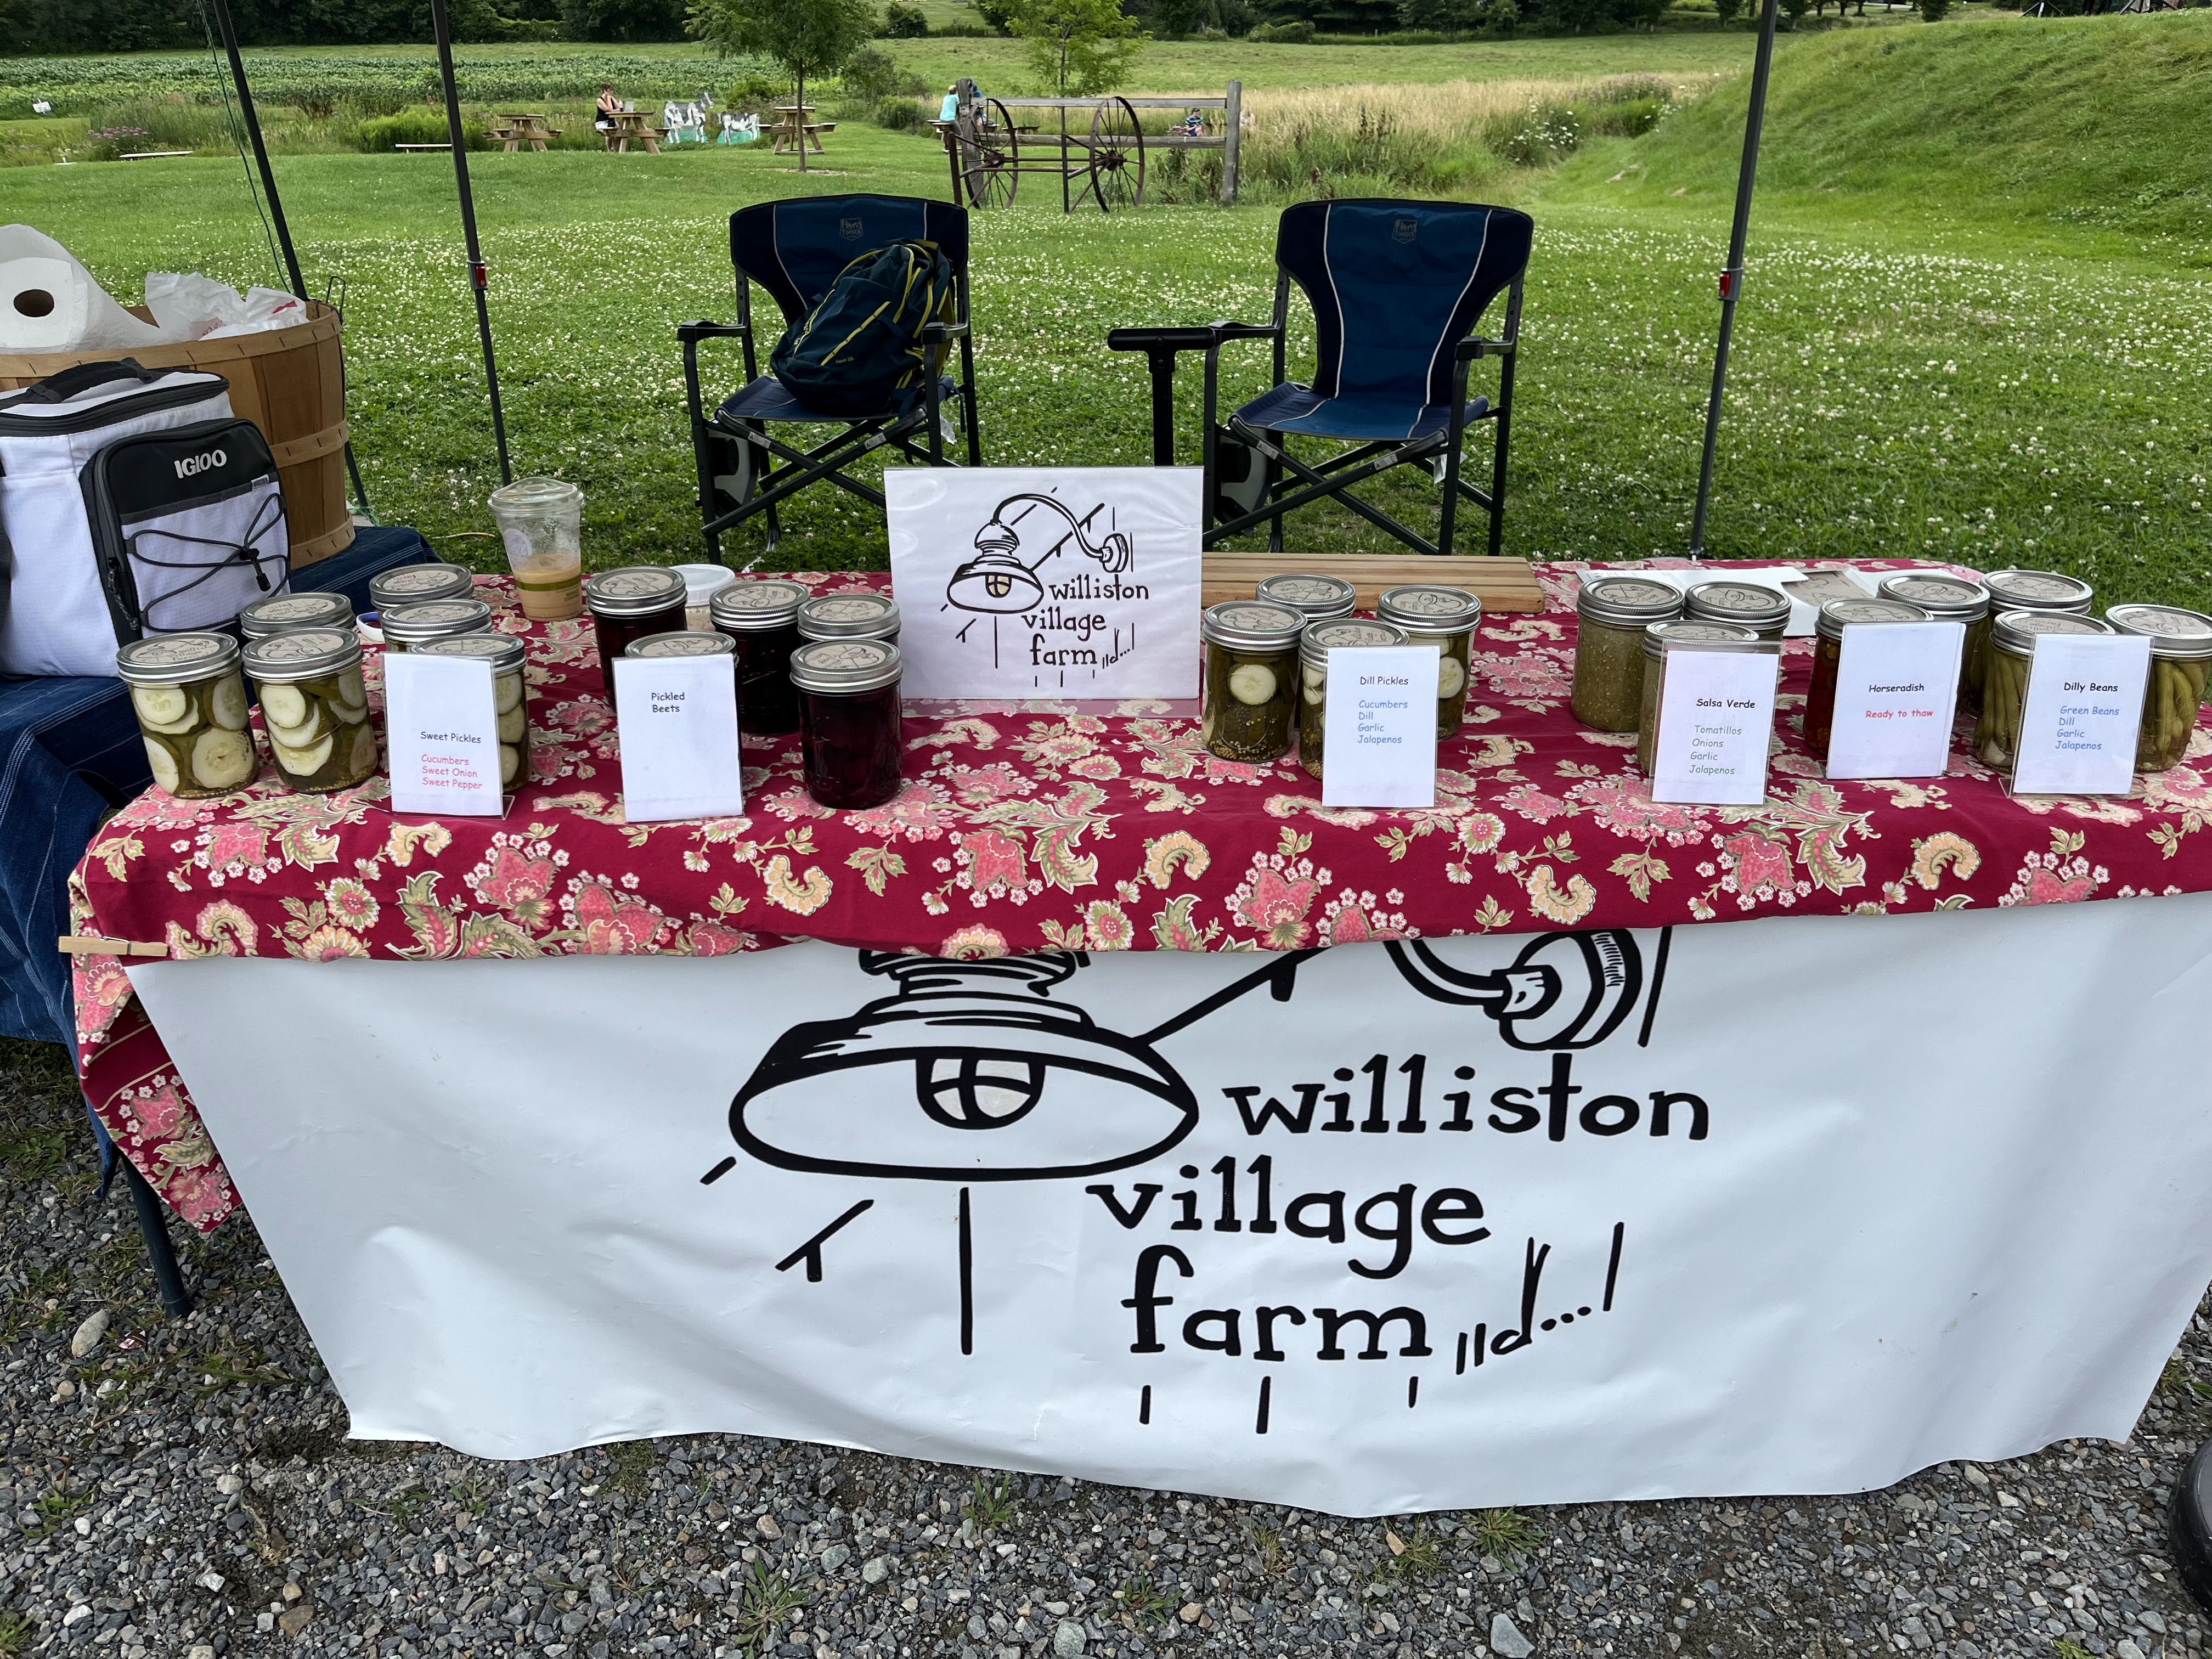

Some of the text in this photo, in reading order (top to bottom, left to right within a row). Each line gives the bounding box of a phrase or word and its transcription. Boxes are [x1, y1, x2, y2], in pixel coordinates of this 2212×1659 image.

[174, 450, 227, 478] IGLOO
[1049, 574, 1149, 601] williston
[1021, 606, 1107, 641] village
[1030, 634, 1097, 666] farm
[1361, 676, 1408, 685] Dill Pickles
[1869, 683, 1924, 692] Horseradish
[2064, 682, 2118, 693] Dilly Beans
[651, 692, 685, 701] Pickled
[1359, 700, 1408, 708] Cucumbers
[1696, 698, 1755, 708] Salsa Verde
[652, 704, 680, 713] Beets
[2061, 706, 2119, 715] Green Beans
[1359, 712, 1373, 720] Dill
[1866, 710, 1893, 720] Ready
[1358, 723, 1384, 731] Garlic
[1695, 725, 1741, 735] Tomatillos
[420, 731, 481, 743] Sweet Pickles
[2057, 729, 2085, 737] Garlic
[1358, 735, 1402, 745] Jalapenos
[1692, 738, 1723, 747] Onions
[2055, 741, 2102, 751] Jalapenos
[421, 754, 469, 766] Cucumbers
[1691, 752, 1718, 760] Garlic
[422, 766, 478, 777] Sweet Onion
[1689, 765, 1735, 776] Jalapenos
[422, 777, 483, 791] Sweet Pepper
[1222, 1053, 1709, 1142] williston
[1085, 1154, 1491, 1279] village
[1121, 1244, 1433, 1362] farm
